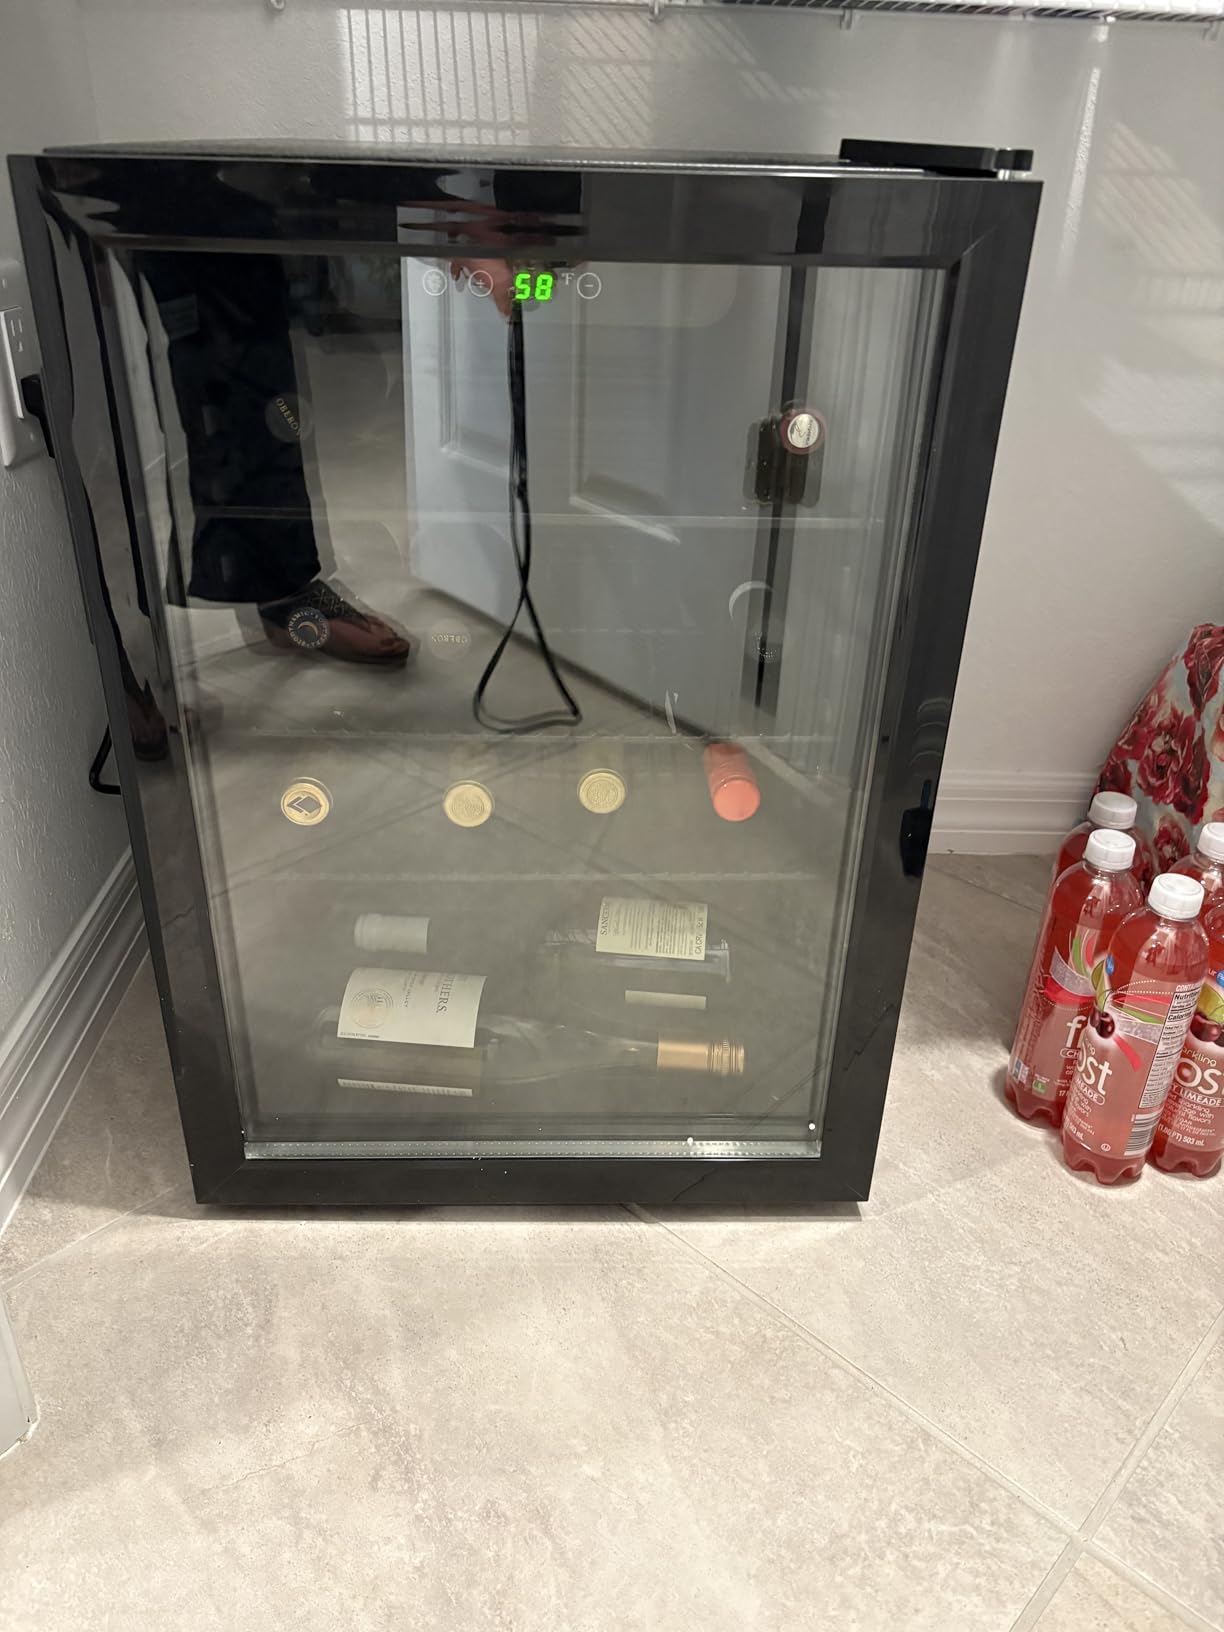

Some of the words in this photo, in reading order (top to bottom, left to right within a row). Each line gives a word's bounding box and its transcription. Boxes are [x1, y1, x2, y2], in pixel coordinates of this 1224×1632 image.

[514, 273, 554, 300] 58
[436, 975, 455, 1013] THERS.
[1183, 1046, 1217, 1067] arkling
[1180, 1088, 1222, 1107] LIMEADE
